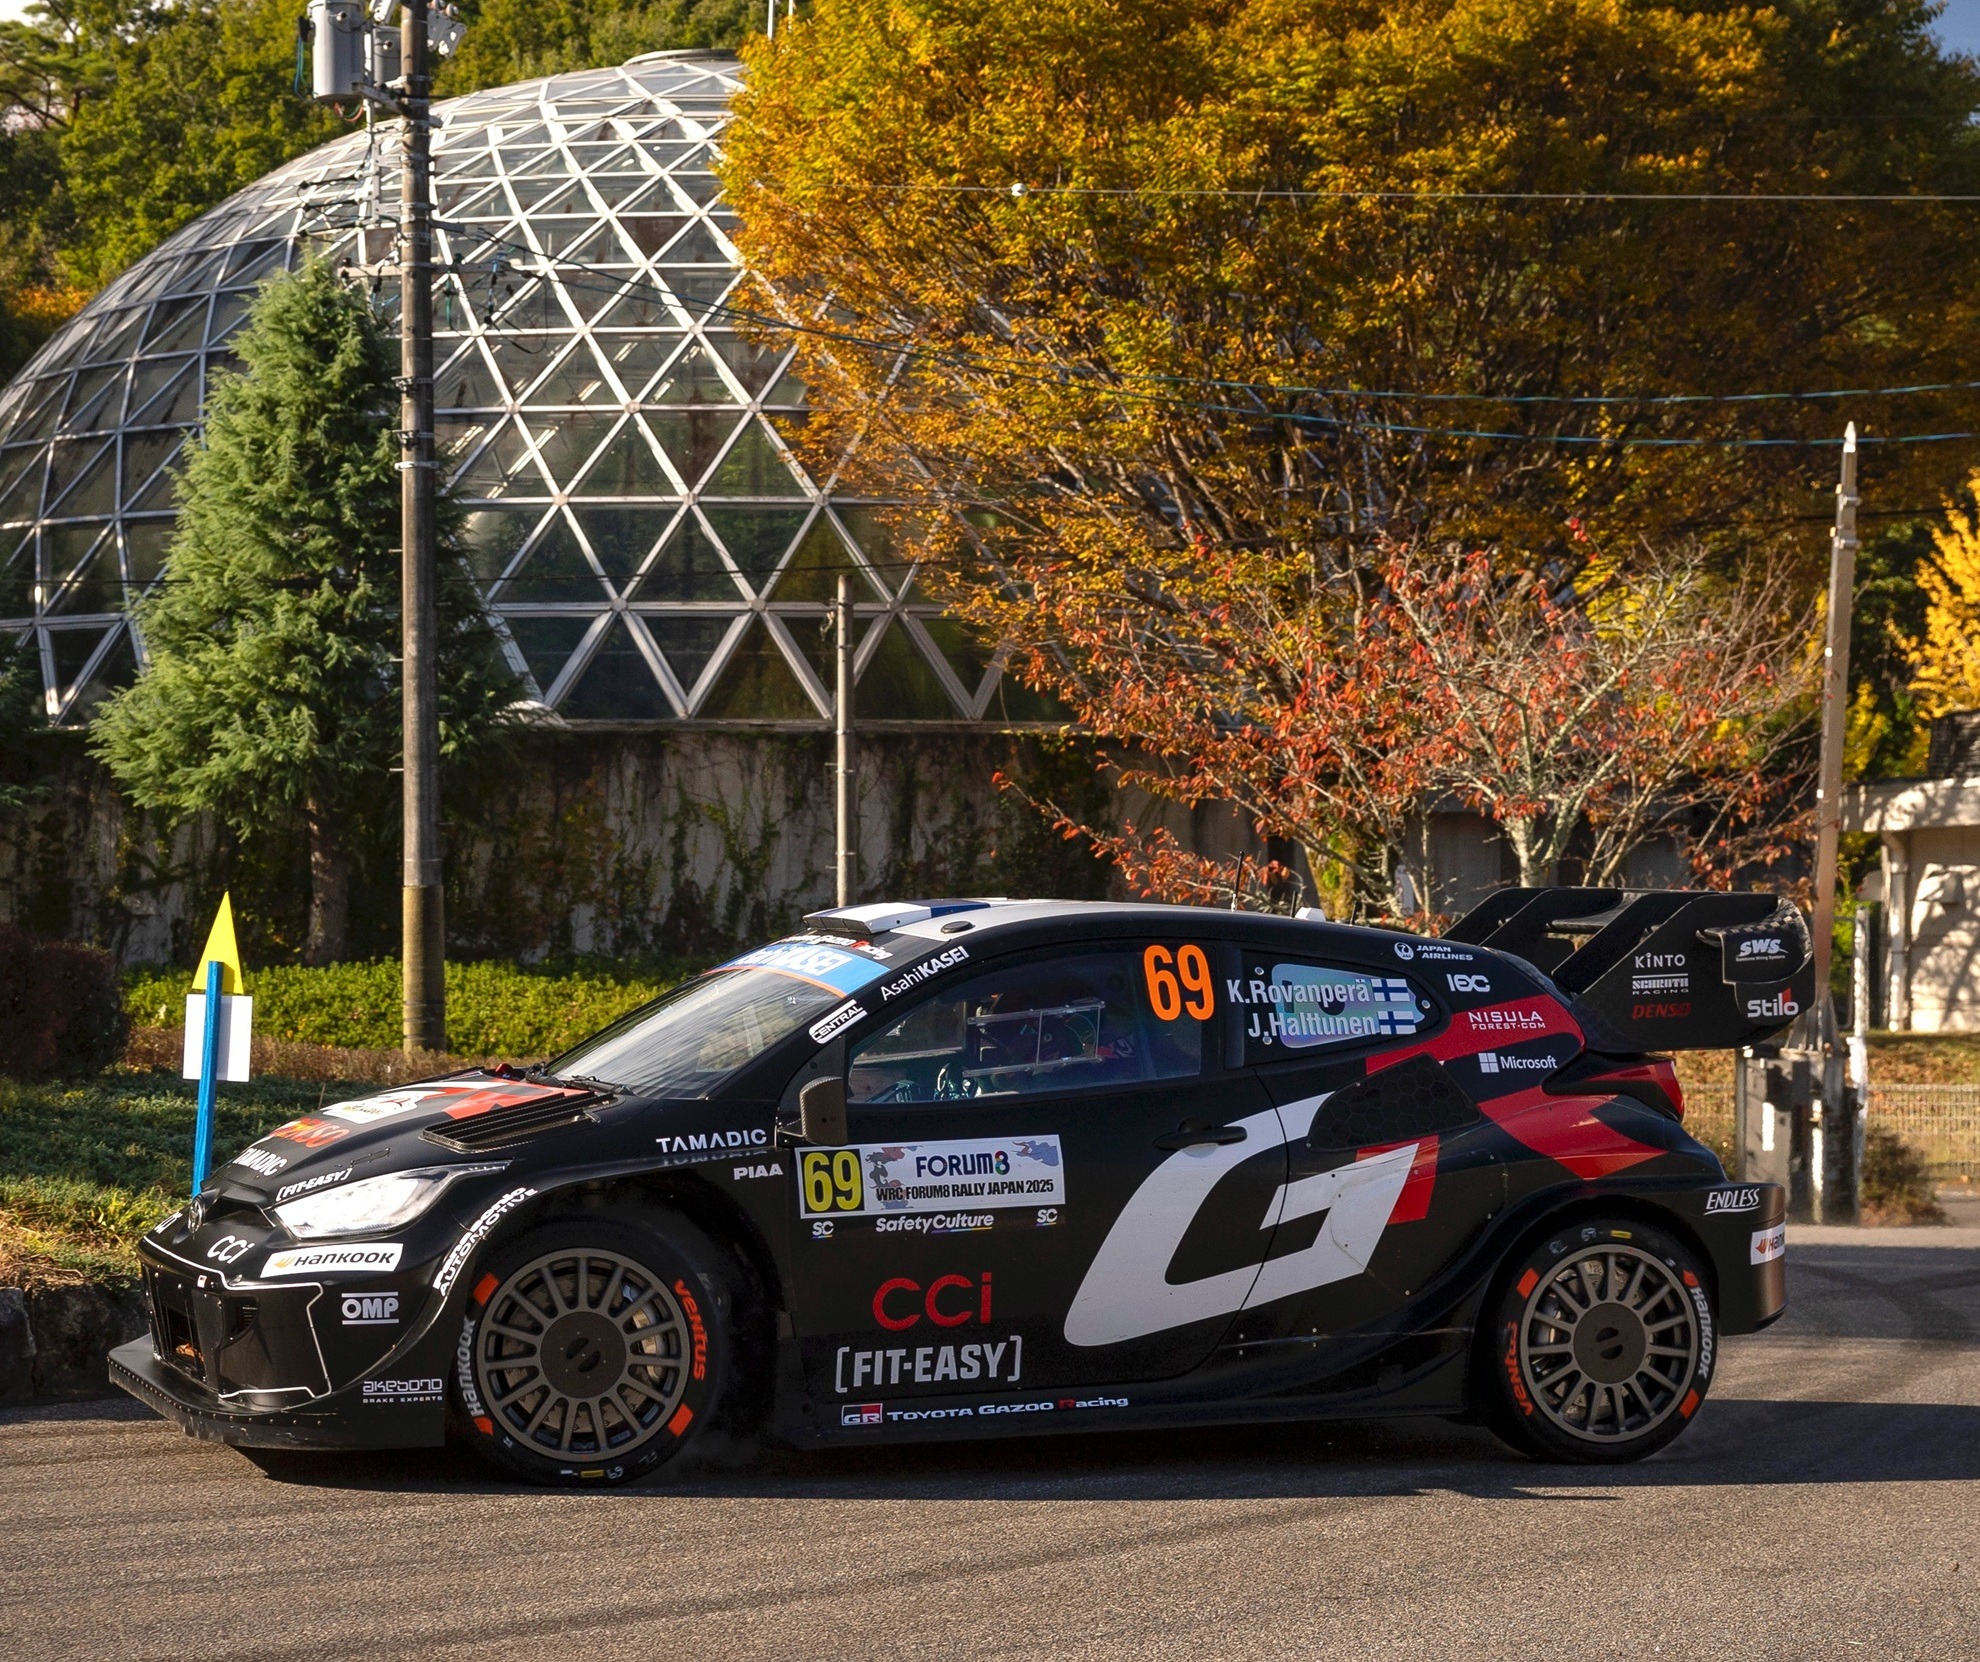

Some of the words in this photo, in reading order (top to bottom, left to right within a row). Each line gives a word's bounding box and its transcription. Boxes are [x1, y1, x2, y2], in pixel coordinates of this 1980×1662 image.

[1416, 944, 1452, 952] JAPAN
[1422, 952, 1474, 961] AIRLINES
[1740, 938, 1781, 957] SWS
[880, 945, 970, 1001] AsahiKASEI
[1143, 944, 1215, 1021] 69
[1632, 978, 1689, 990] SCHROTH
[1226, 978, 1370, 1008] K.Rovanperä
[1747, 988, 1799, 1018] Stilo
[1468, 1011, 1543, 1023] NISULA
[1632, 1002, 1692, 1020] DENSO
[811, 1005, 864, 1042] CENTRAL
[1248, 1012, 1378, 1039] J.Halttunen
[1500, 1055, 1558, 1069] Microsoft
[655, 1128, 768, 1153] TAMADIC
[733, 1163, 783, 1180] PIAA
[916, 1150, 1011, 1177] FORUM8
[803, 1151, 861, 1212] 69
[876, 1187, 903, 1202] WRC
[906, 1184, 950, 1200] FORUM8
[951, 1182, 986, 1198] RALLY
[987, 1180, 1026, 1195] JAPAN
[1026, 1179, 1054, 1194] 2025
[1705, 1188, 1760, 1211] ENDLESS
[875, 1212, 995, 1234] SafetyCulture
[1037, 1208, 1058, 1224] SC
[812, 1221, 834, 1236] SC
[440, 1188, 539, 1297] AUTOMOTIVE
[342, 1297, 399, 1319] OMP
[843, 1412, 882, 1425] GR
[887, 1408, 973, 1421] TOYOTA
[978, 1401, 1054, 1415] GAZOO
[1058, 1396, 1129, 1410] Racing
